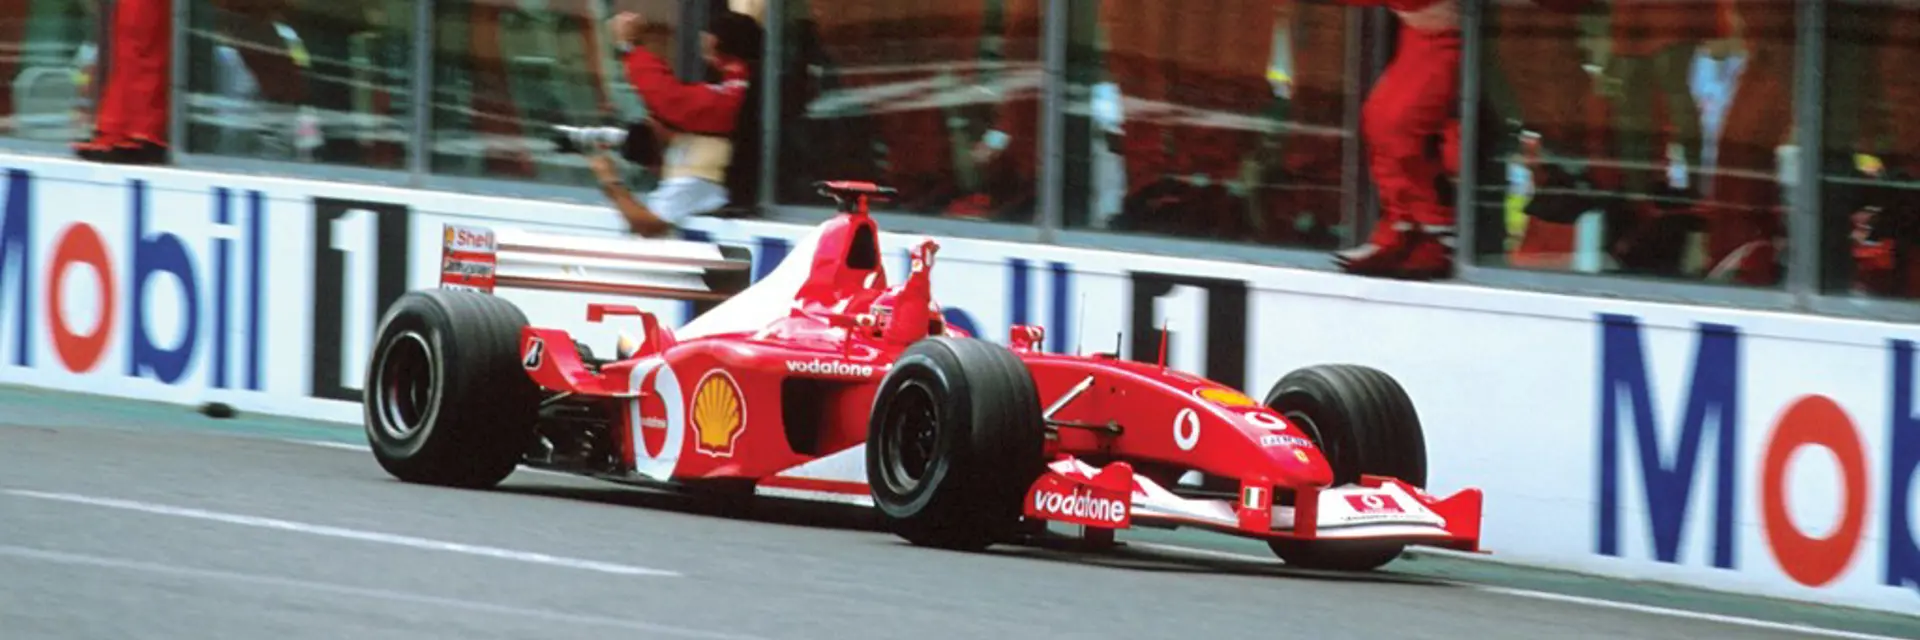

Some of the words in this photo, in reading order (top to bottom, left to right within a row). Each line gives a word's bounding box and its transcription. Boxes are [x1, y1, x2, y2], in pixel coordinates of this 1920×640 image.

[329, 208, 379, 391] 1
[785, 358, 872, 376] vodafone
[1034, 487, 1126, 522] vodafone
[1594, 312, 1920, 594] Mo
